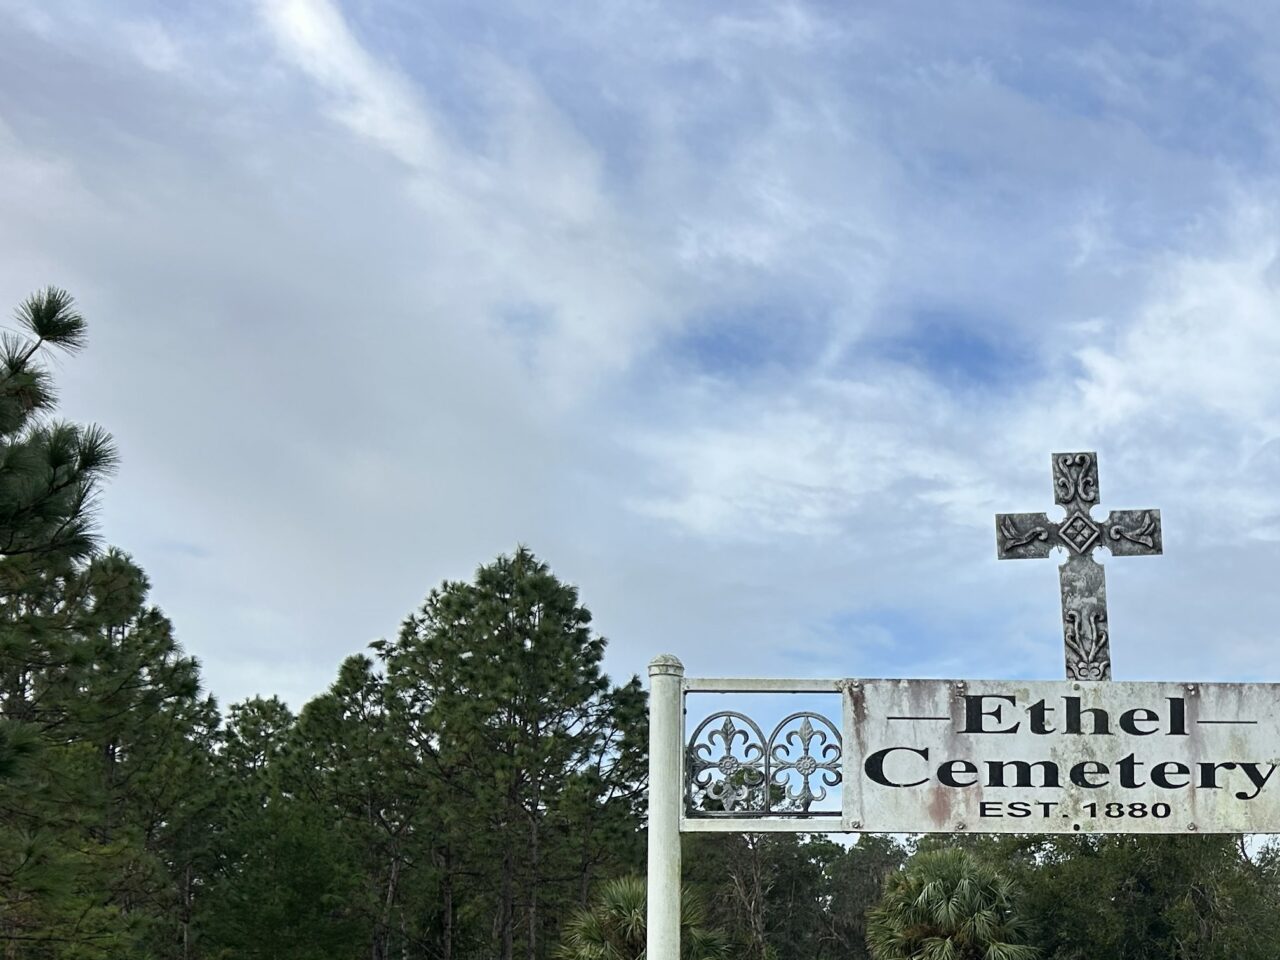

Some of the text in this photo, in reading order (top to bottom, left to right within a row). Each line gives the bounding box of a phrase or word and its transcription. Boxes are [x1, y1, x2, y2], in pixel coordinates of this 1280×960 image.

[957, 694, 1190, 736] Ethel
[864, 746, 1278, 800] Cemetery
[979, 801, 1172, 819] EST. 1880
